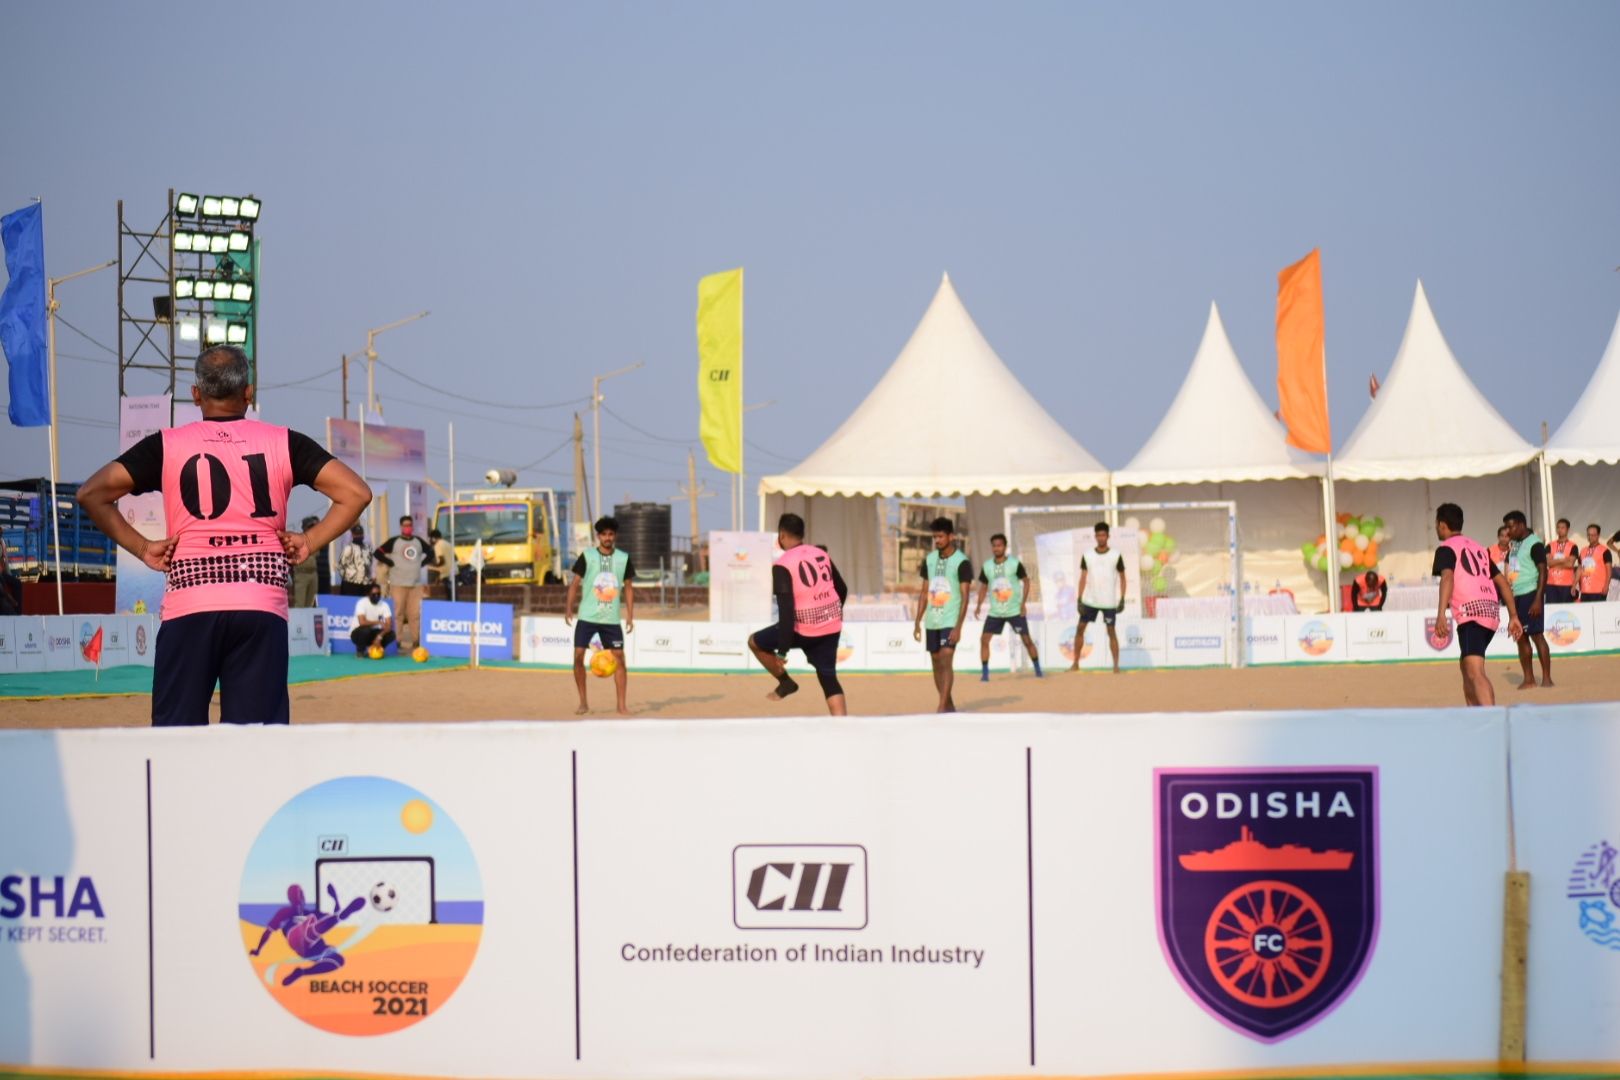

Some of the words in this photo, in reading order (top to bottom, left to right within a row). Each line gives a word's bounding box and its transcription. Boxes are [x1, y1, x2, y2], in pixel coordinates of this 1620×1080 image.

[180, 452, 278, 521] 01
[798, 556, 832, 588] 05
[1180, 791, 1355, 819] ODISHA
[321, 839, 344, 852] CII
[746, 862, 854, 912] CII
[8, 926, 43, 942] KEPT
[49, 926, 107, 943] SECRET.
[1254, 934, 1284, 953] FC
[621, 943, 778, 962] Confederation
[785, 943, 808, 962] of
[815, 944, 883, 963] Indian
[891, 945, 985, 968] Industry
[310, 980, 364, 993] BEACH
[368, 981, 428, 994] SOCCER
[373, 997, 428, 1015] 2021
